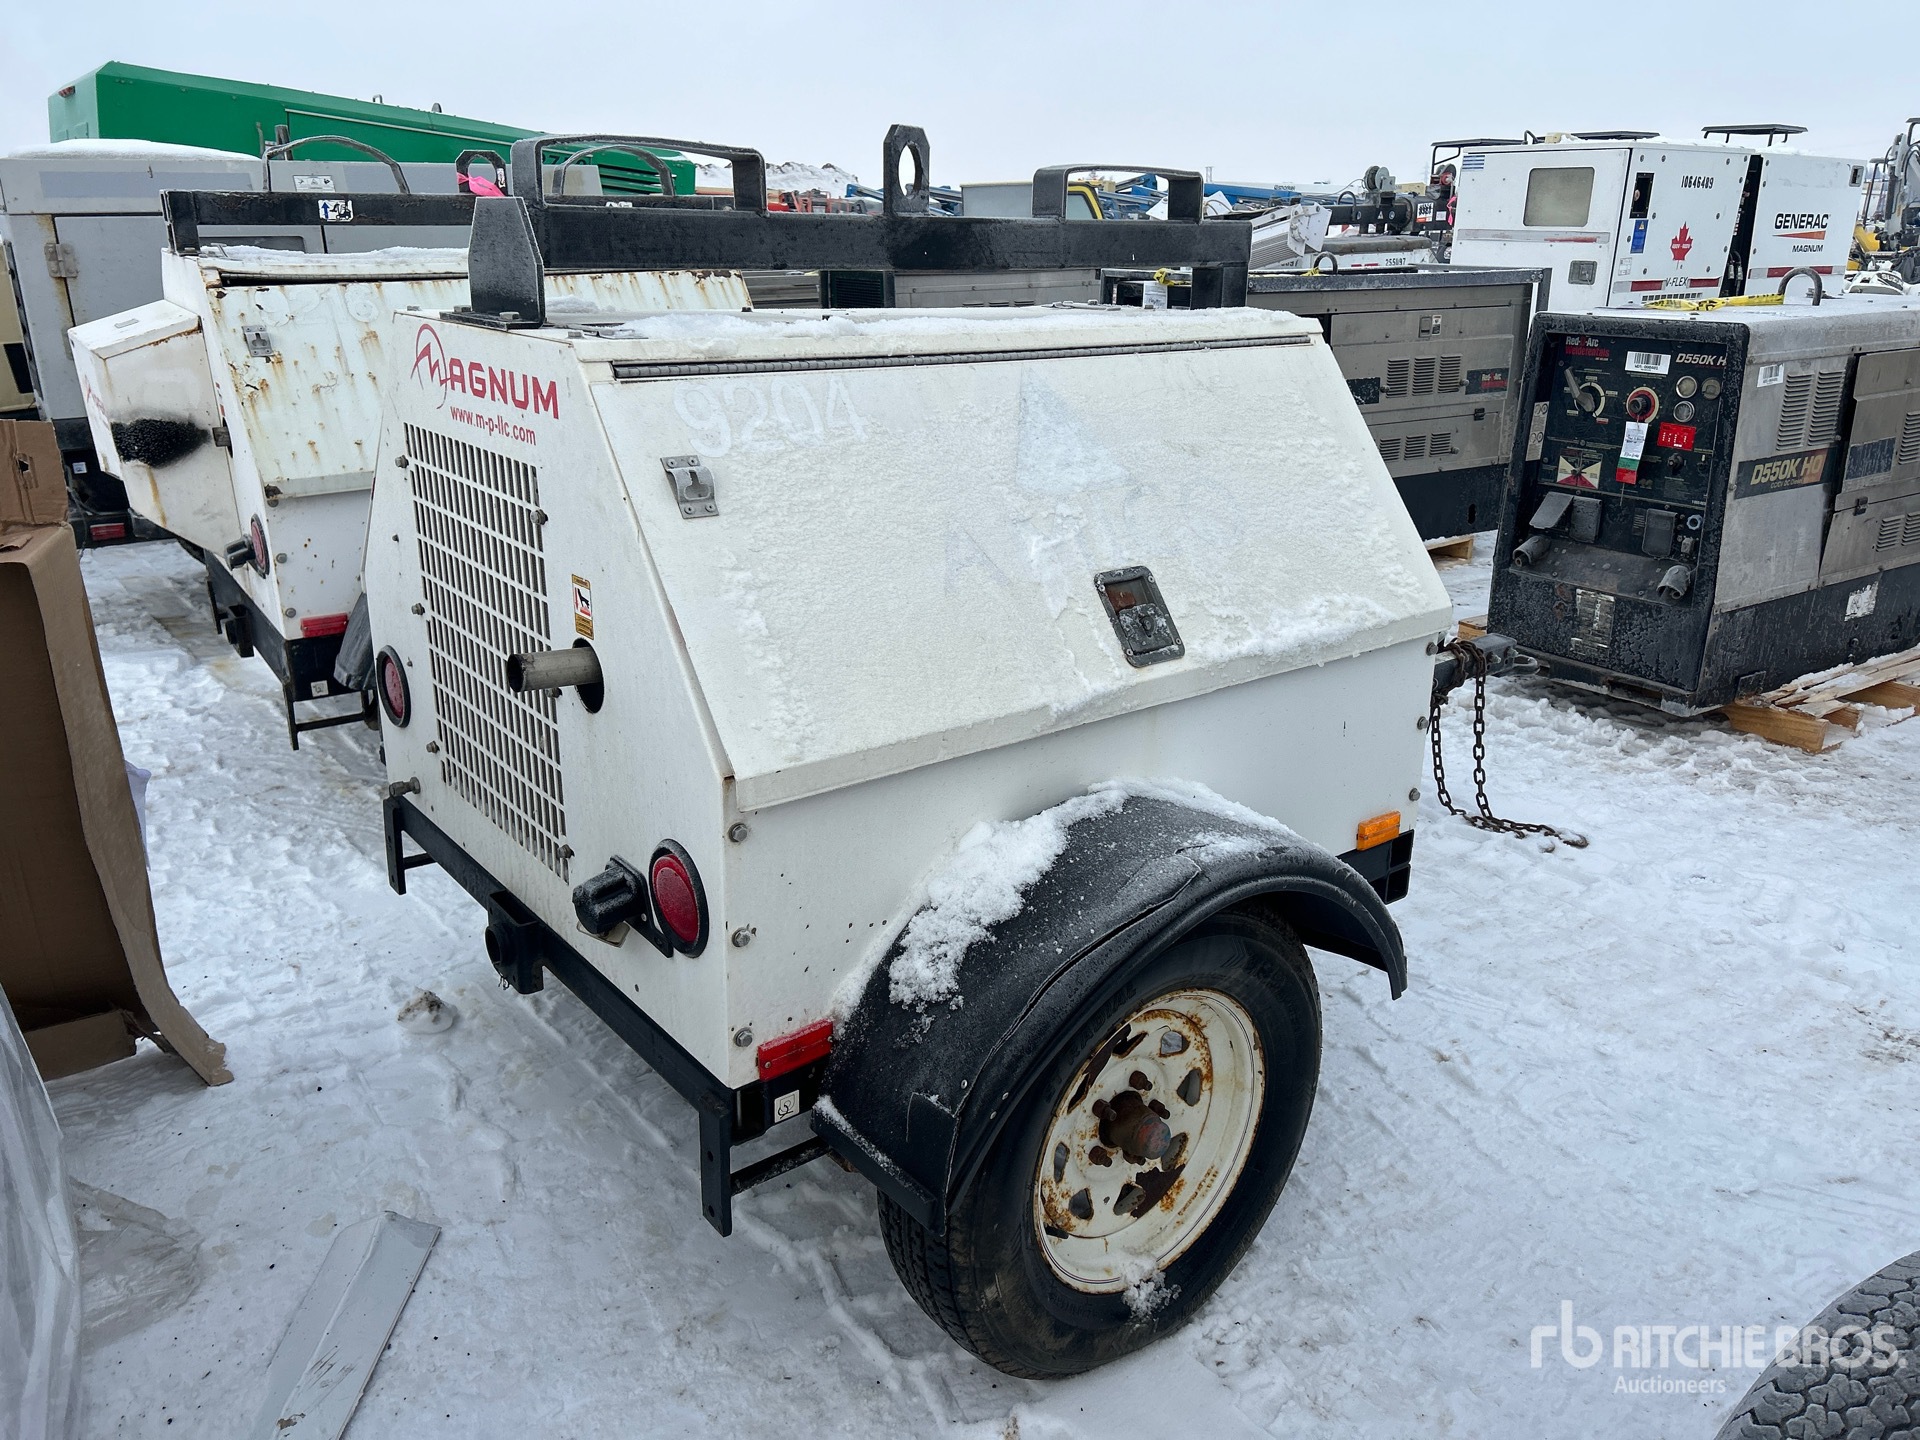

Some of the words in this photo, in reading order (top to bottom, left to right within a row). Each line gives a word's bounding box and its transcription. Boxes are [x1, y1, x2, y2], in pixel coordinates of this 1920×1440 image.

[1681, 175, 1714, 189] 10646489
[1774, 213, 1829, 230] GENERAC
[1791, 244, 1824, 253] MAGNUM
[1665, 277, 1689, 287] V-FLEX
[1675, 353, 1717, 365] D550K
[672, 376, 870, 458] 9204
[450, 406, 536, 446] www.m-p-llc.com
[1750, 457, 1801, 486] D550K
